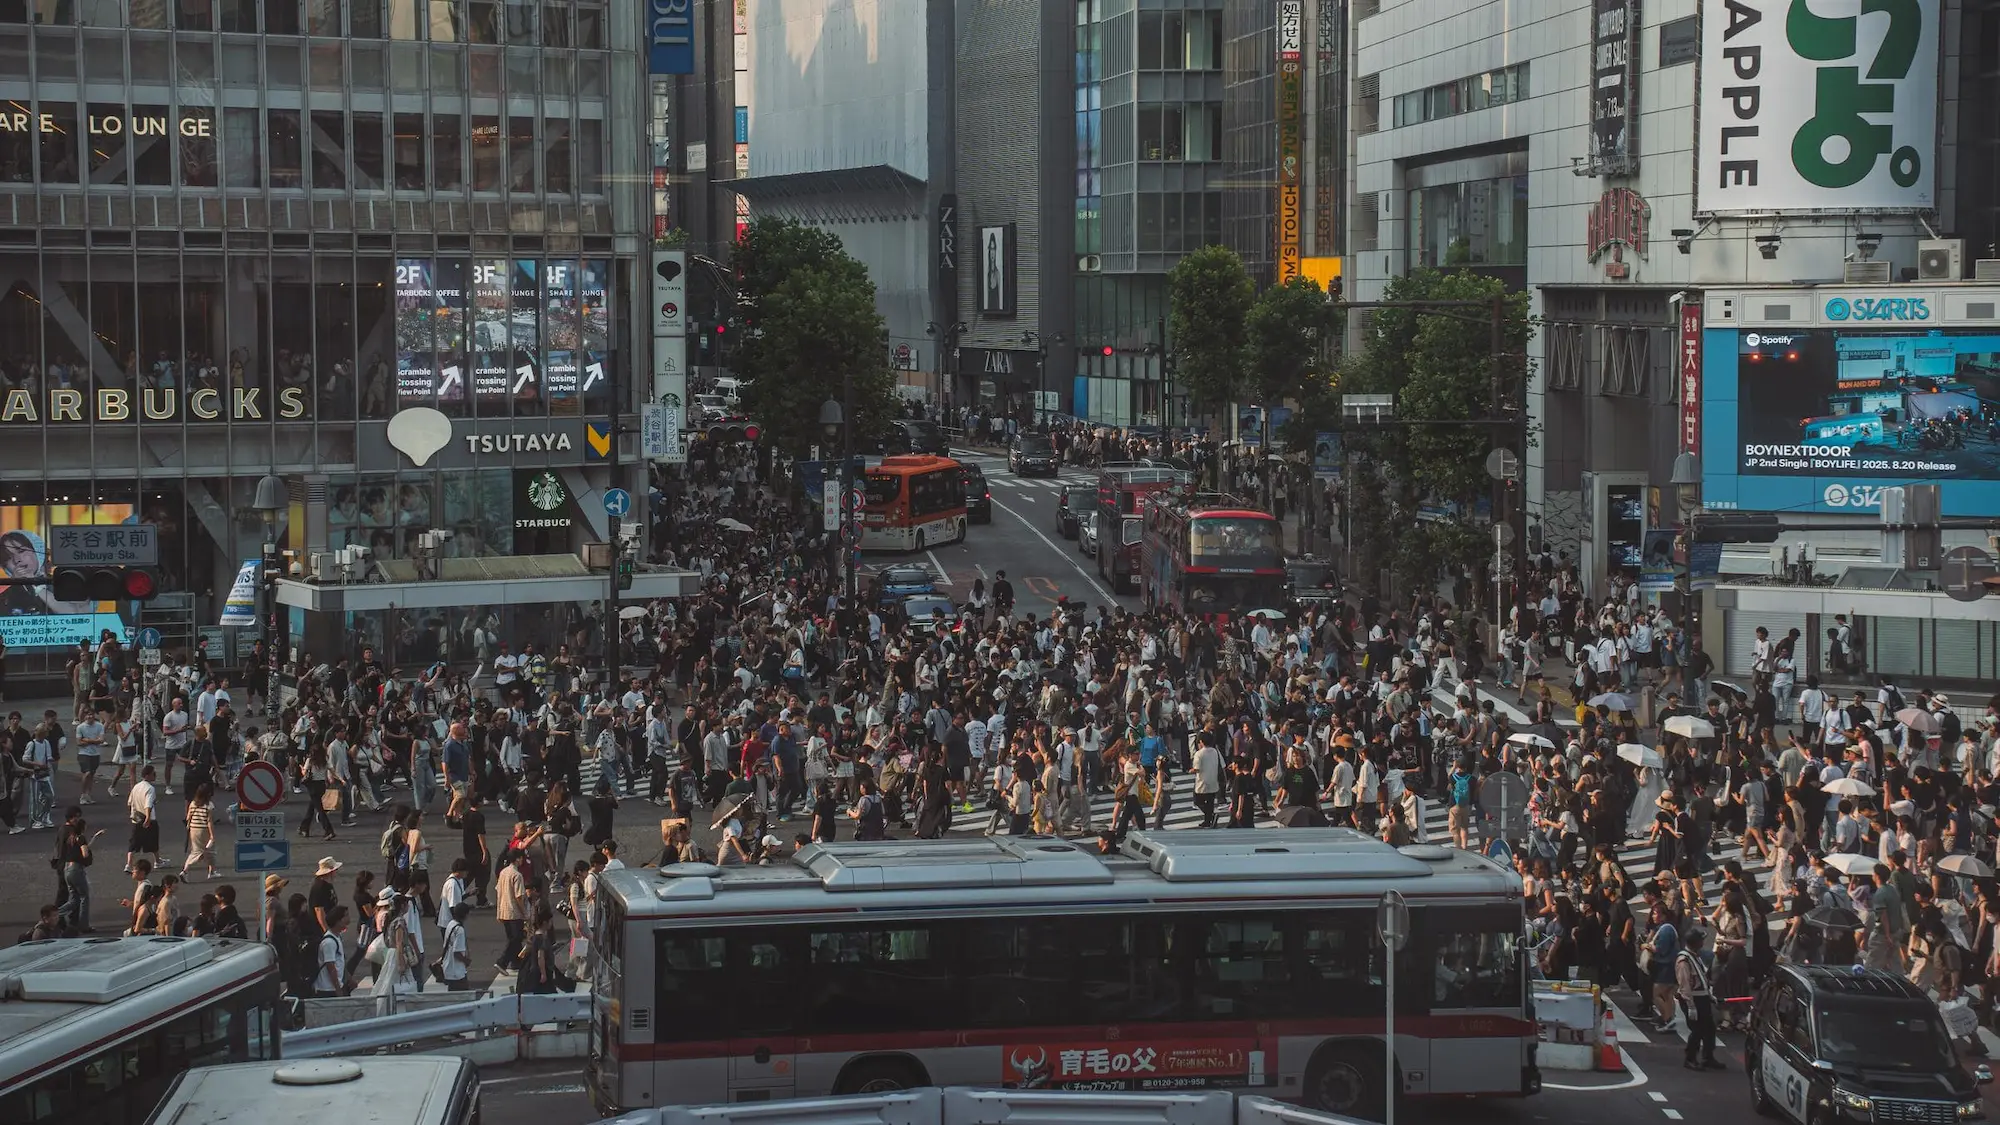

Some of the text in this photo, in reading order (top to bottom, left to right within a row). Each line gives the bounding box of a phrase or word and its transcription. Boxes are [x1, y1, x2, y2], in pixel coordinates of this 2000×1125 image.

[1283, 3, 1299, 49] 処方せん
[1720, 0, 1762, 189] APPLE
[89, 115, 211, 137] LOUNGE
[1285, 184, 1297, 241] TOUCH
[940, 206, 954, 269] ZARA
[396, 265, 421, 284] 2F
[1284, 246, 1297, 288] OM'S
[397, 289, 432, 297] TARBUCKS
[1852, 297, 1930, 321] STARTS
[1761, 334, 1793, 346] Spotify
[476, 366, 506, 375] cramble
[984, 350, 1013, 373] ZARA
[476, 376, 507, 386] rossing
[548, 375, 577, 384] rossing
[1838, 381, 1853, 389] RUN
[488, 386, 505, 394] Point
[1, 388, 305, 421] ARBUCKS
[651, 408, 662, 454] 渋谷駅前
[466, 433, 572, 453] TSUTAYA
[1745, 444, 1851, 457] BOYNEXTDOOR
[1745, 459, 1759, 468] JP
[1759, 459, 1778, 468] 2nd
[1778, 459, 1808, 469] Single
[1892, 460, 1916, 470] 8.20
[1917, 461, 1957, 471] Release
[59, 529, 148, 549] 渋谷駅前
[73, 550, 139, 562] Shibuya Sta.
[1060, 1046, 1157, 1075] 育毛の父
[1207, 1051, 1235, 1068] No.1
